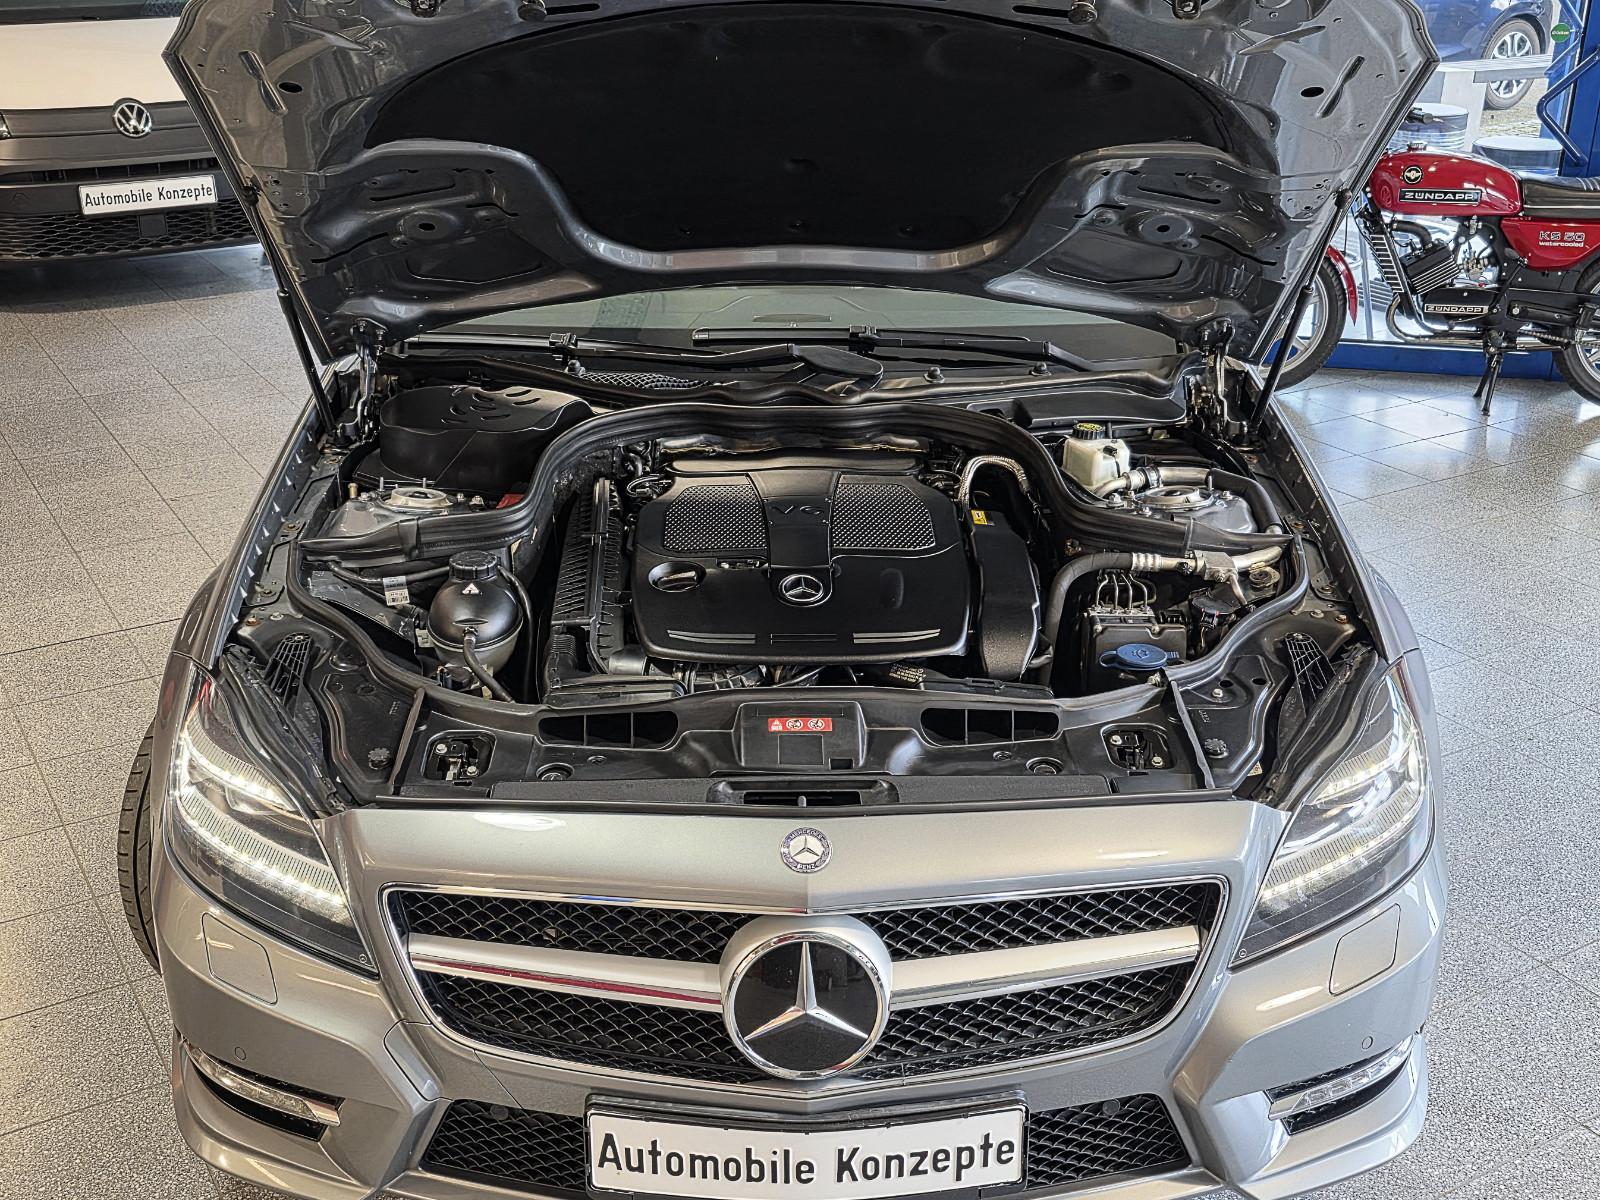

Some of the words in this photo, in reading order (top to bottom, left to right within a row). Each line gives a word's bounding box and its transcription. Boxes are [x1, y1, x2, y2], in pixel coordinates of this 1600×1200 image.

[85, 189, 153, 207] Automobile
[157, 183, 213, 201] Konzepte
[1539, 231, 1560, 241] KS
[1564, 231, 1586, 242] 50
[770, 504, 825, 515] V6
[597, 1132, 815, 1185] Automobile
[836, 1132, 1016, 1183] Konzepte
